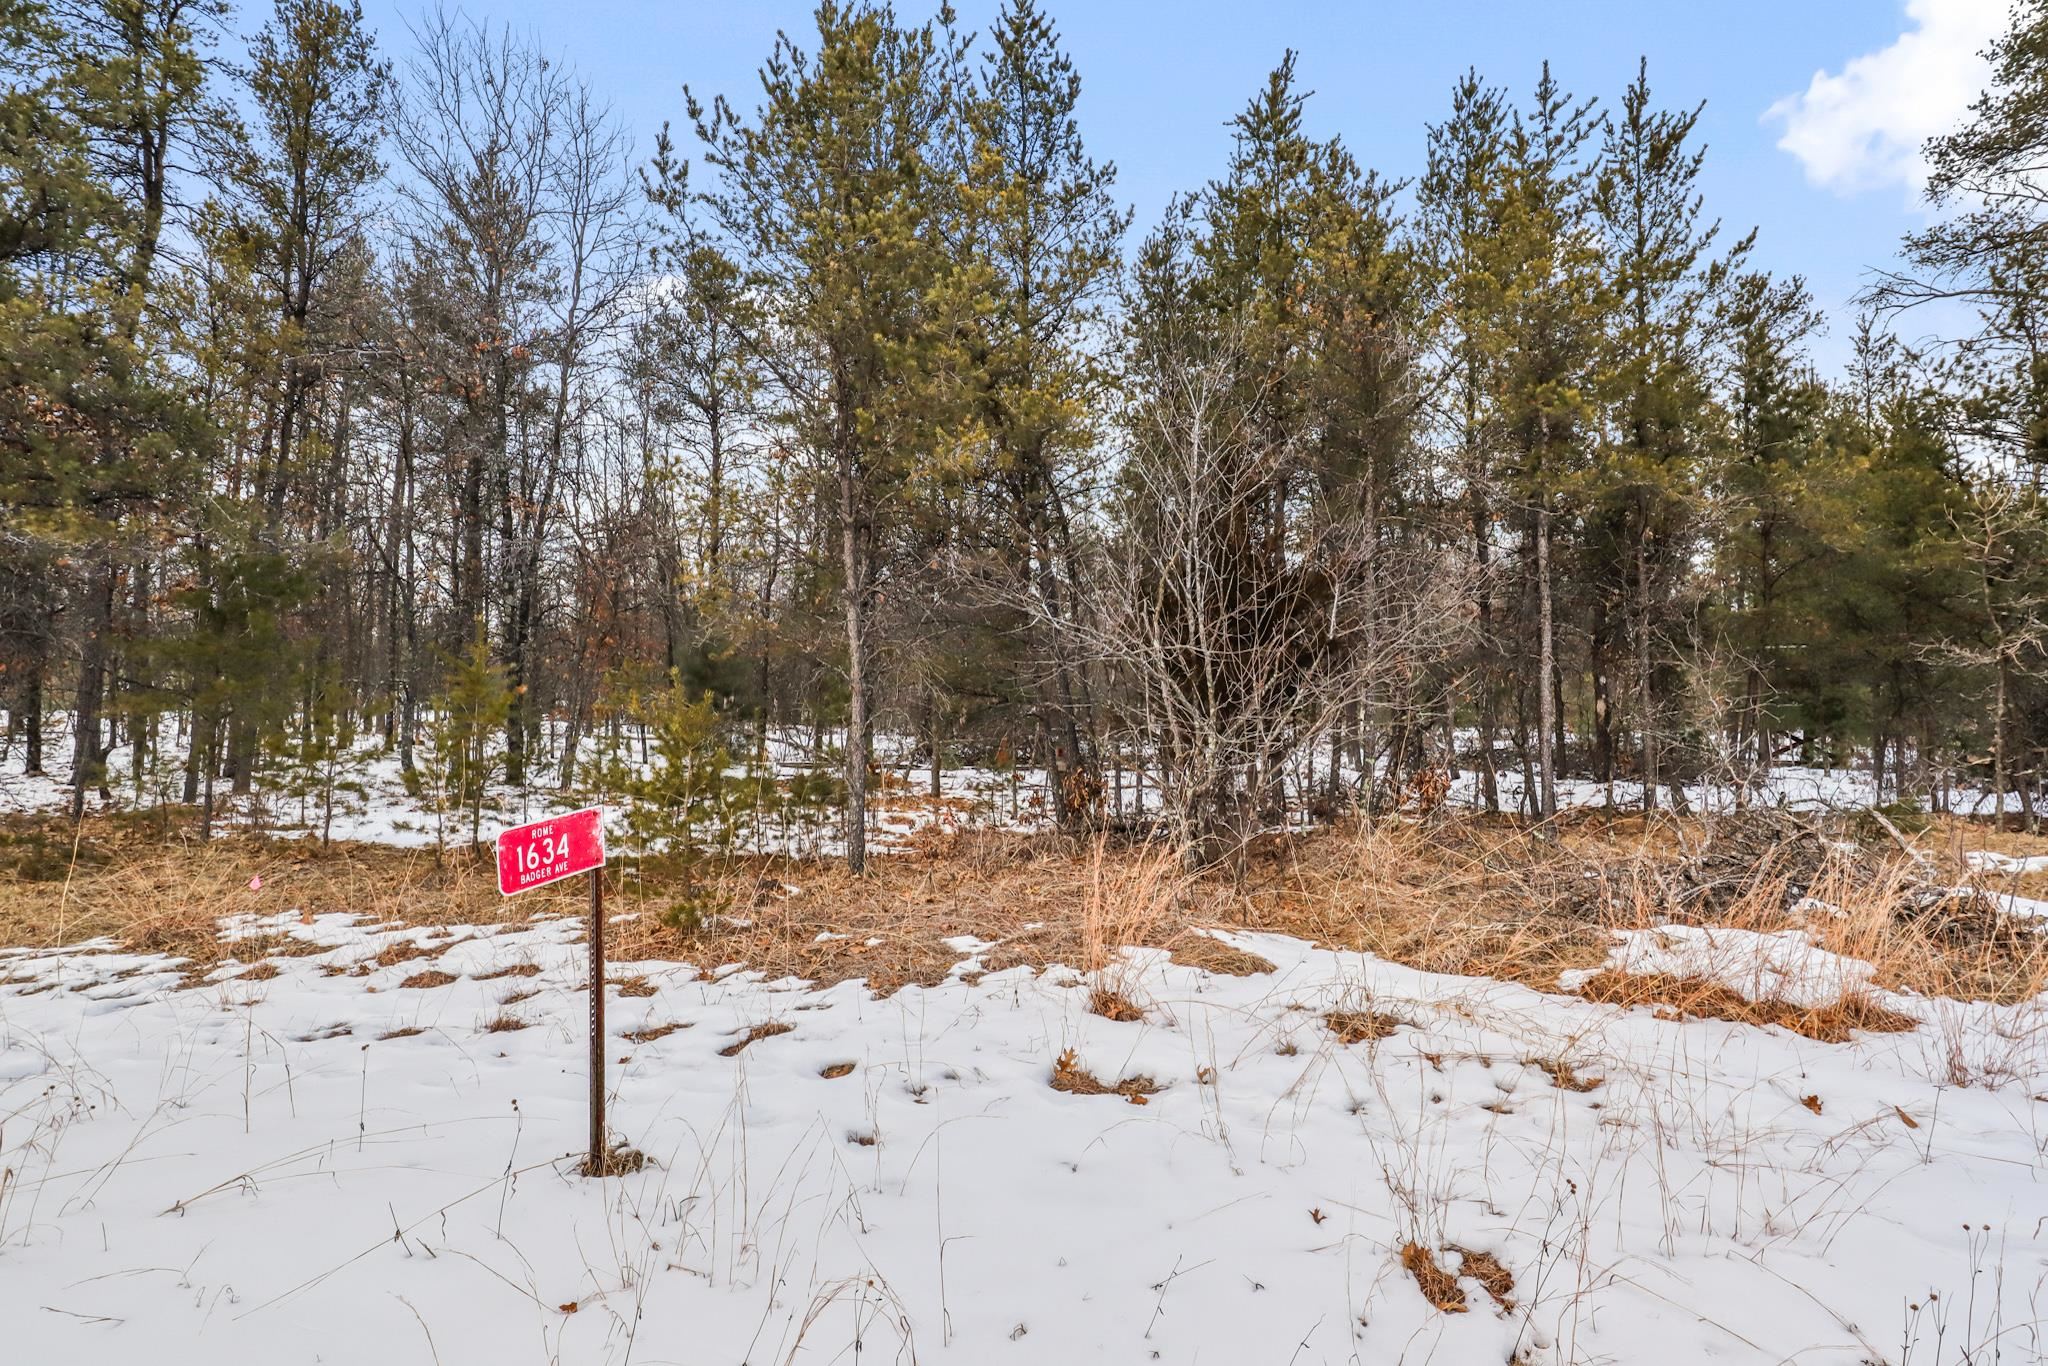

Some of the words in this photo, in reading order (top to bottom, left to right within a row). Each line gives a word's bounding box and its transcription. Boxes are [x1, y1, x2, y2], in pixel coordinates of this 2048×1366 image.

[531, 824, 554, 839] ROME
[516, 833, 569, 873] 1634
[520, 866, 552, 885] BADGER
[554, 861, 569, 874] AVE
